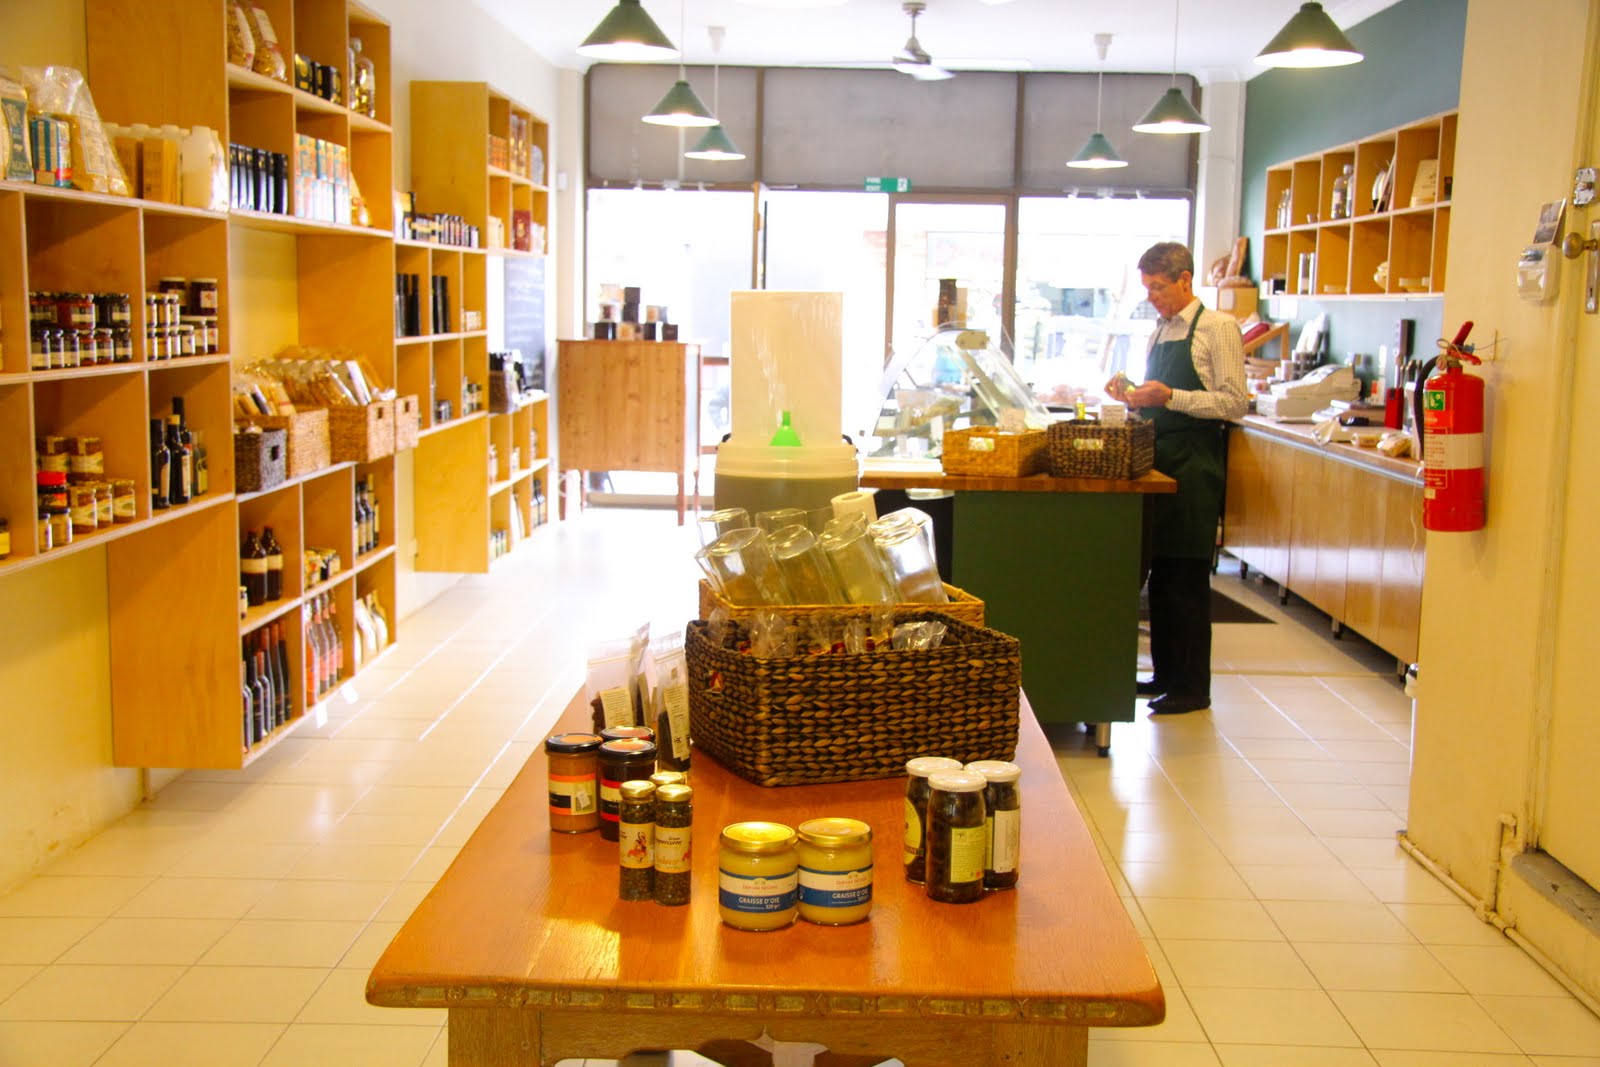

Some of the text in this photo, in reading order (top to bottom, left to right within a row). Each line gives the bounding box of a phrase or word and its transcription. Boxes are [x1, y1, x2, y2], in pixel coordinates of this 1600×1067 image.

[832, 891, 857, 899] GRAISSE
[738, 896, 780, 905] GRAISSE D'OIE
